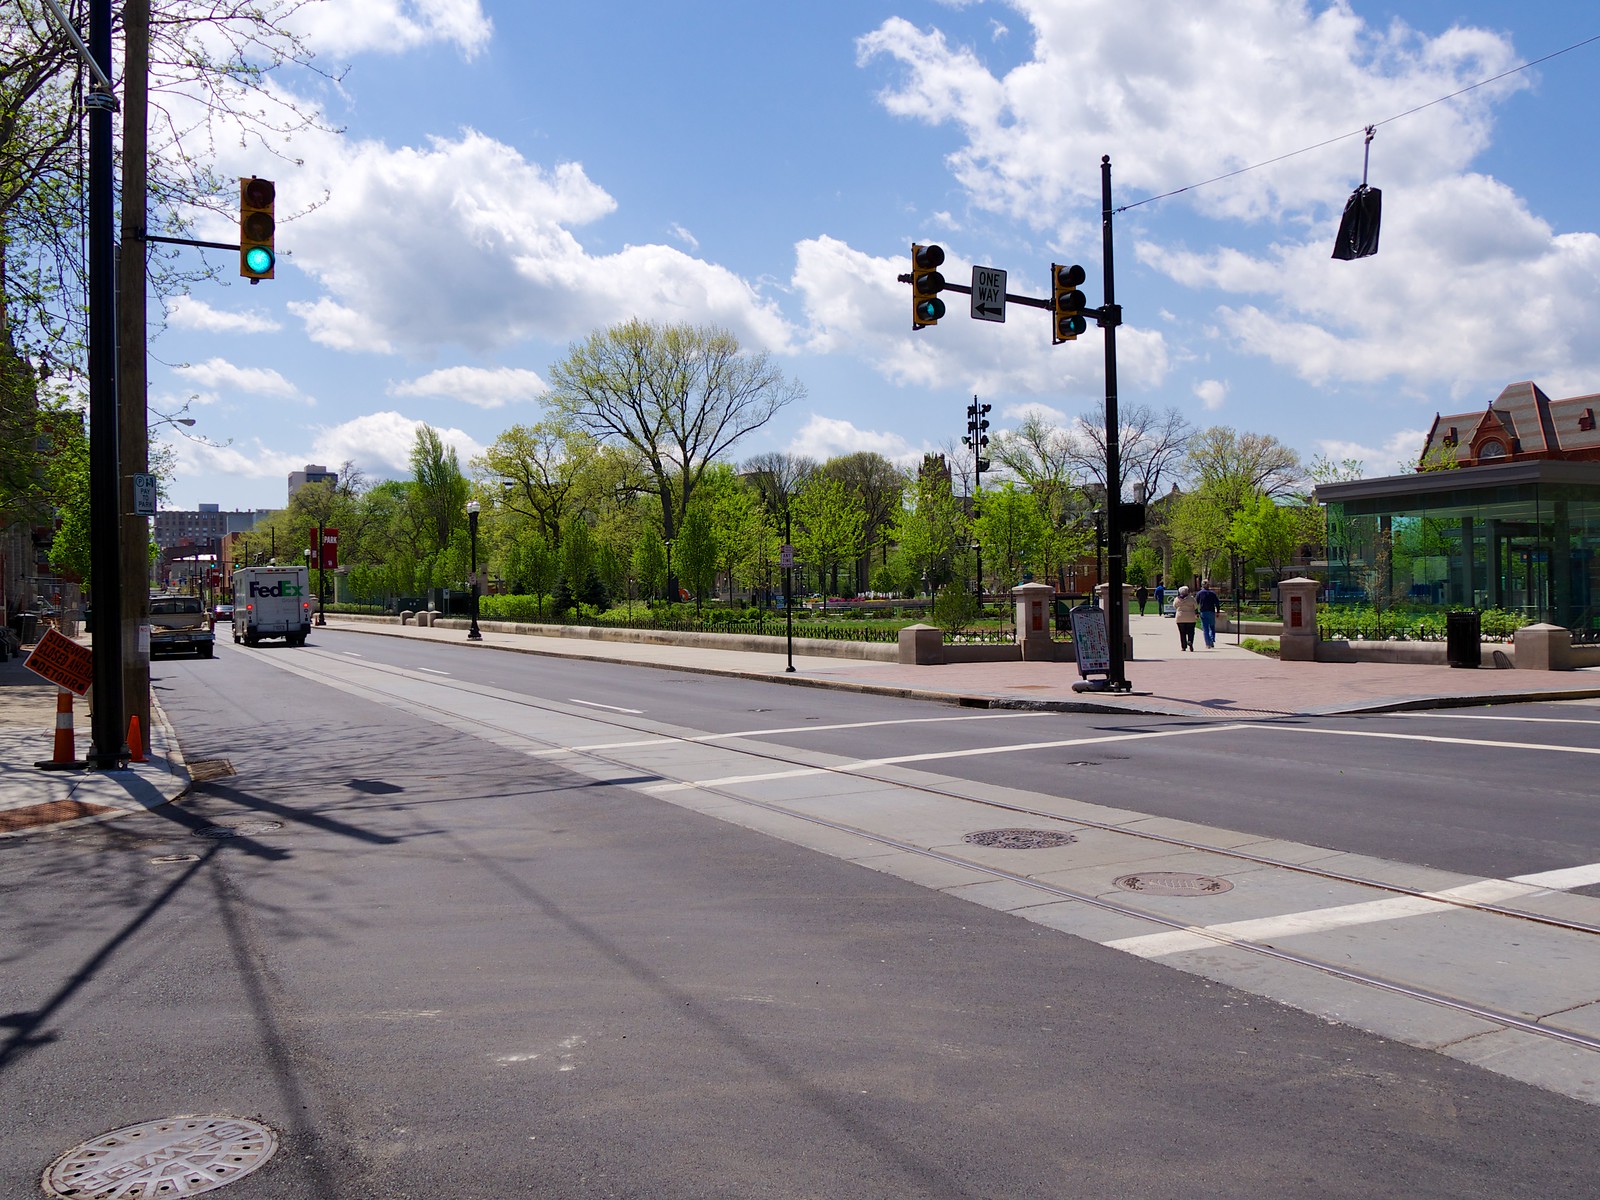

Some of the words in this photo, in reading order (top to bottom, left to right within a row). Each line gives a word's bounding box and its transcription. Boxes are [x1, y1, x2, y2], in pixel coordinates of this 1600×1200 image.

[979, 271, 1000, 288] ONE
[978, 287, 1000, 303] WAY
[324, 536, 338, 544] PARK
[249, 580, 304, 598] FedEx
[38, 642, 70, 667] CLOSED
[46, 632, 93, 665] SIDEWAL
[36, 661, 78, 689] DETOUR
[70, 1124, 245, 1191] SEWER
